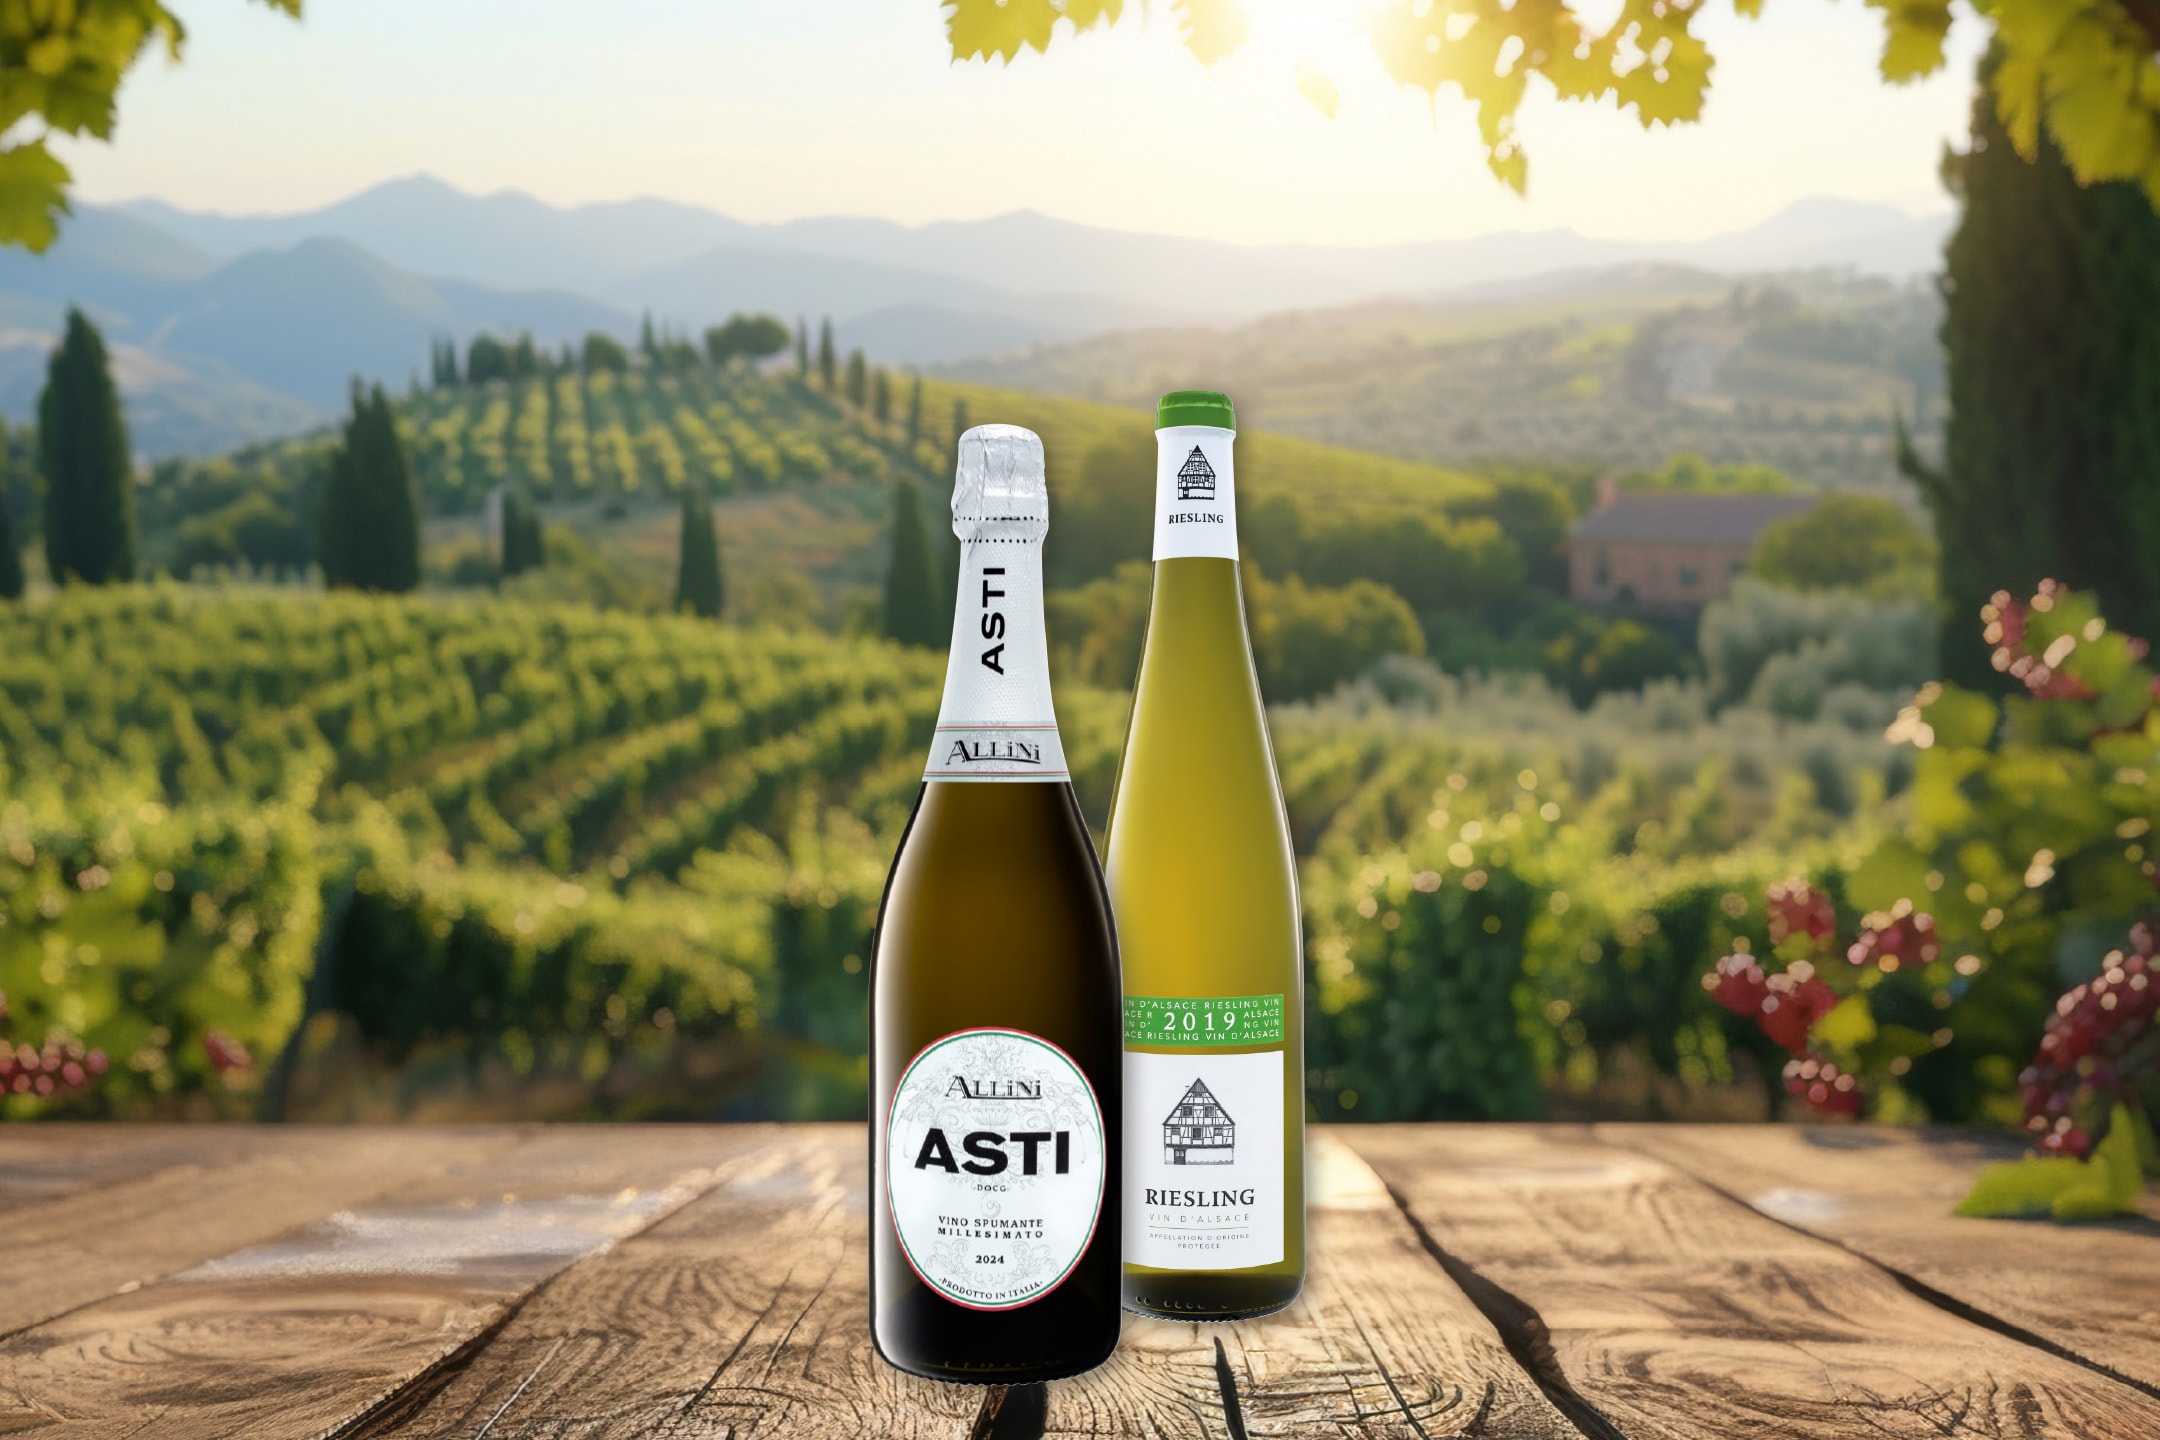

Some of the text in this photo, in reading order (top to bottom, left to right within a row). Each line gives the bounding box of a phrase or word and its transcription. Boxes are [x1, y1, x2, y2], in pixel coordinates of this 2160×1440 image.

[1168, 513, 1224, 525] RIESLING
[981, 567, 1006, 676] ASTI
[1139, 1000, 1198, 1010] D'ALSACE
[1204, 1000, 1259, 1010] RIESLING
[1263, 997, 1280, 1007] VIN
[1243, 1008, 1280, 1019] ALSACE
[1163, 1011, 1236, 1031] 2019
[1263, 1018, 1280, 1028] VIN
[1147, 1031, 1200, 1041] RIESLING
[1205, 1032, 1225, 1041] VIN
[1231, 1029, 1280, 1040] D'ALSACE
[914, 1128, 1070, 1176] ASTI
[1145, 1188, 1255, 1208] RIESLING
[938, 1215, 1044, 1229] VINO SPUMANTE
[1149, 1213, 1250, 1223] VIN D'ALSACE
[937, 1227, 1043, 1240] MILLESIMATO
[1149, 1233, 1203, 1241] APPELLATION
[975, 1254, 1005, 1264] 2024
[995, 1291, 1006, 1300] IN
